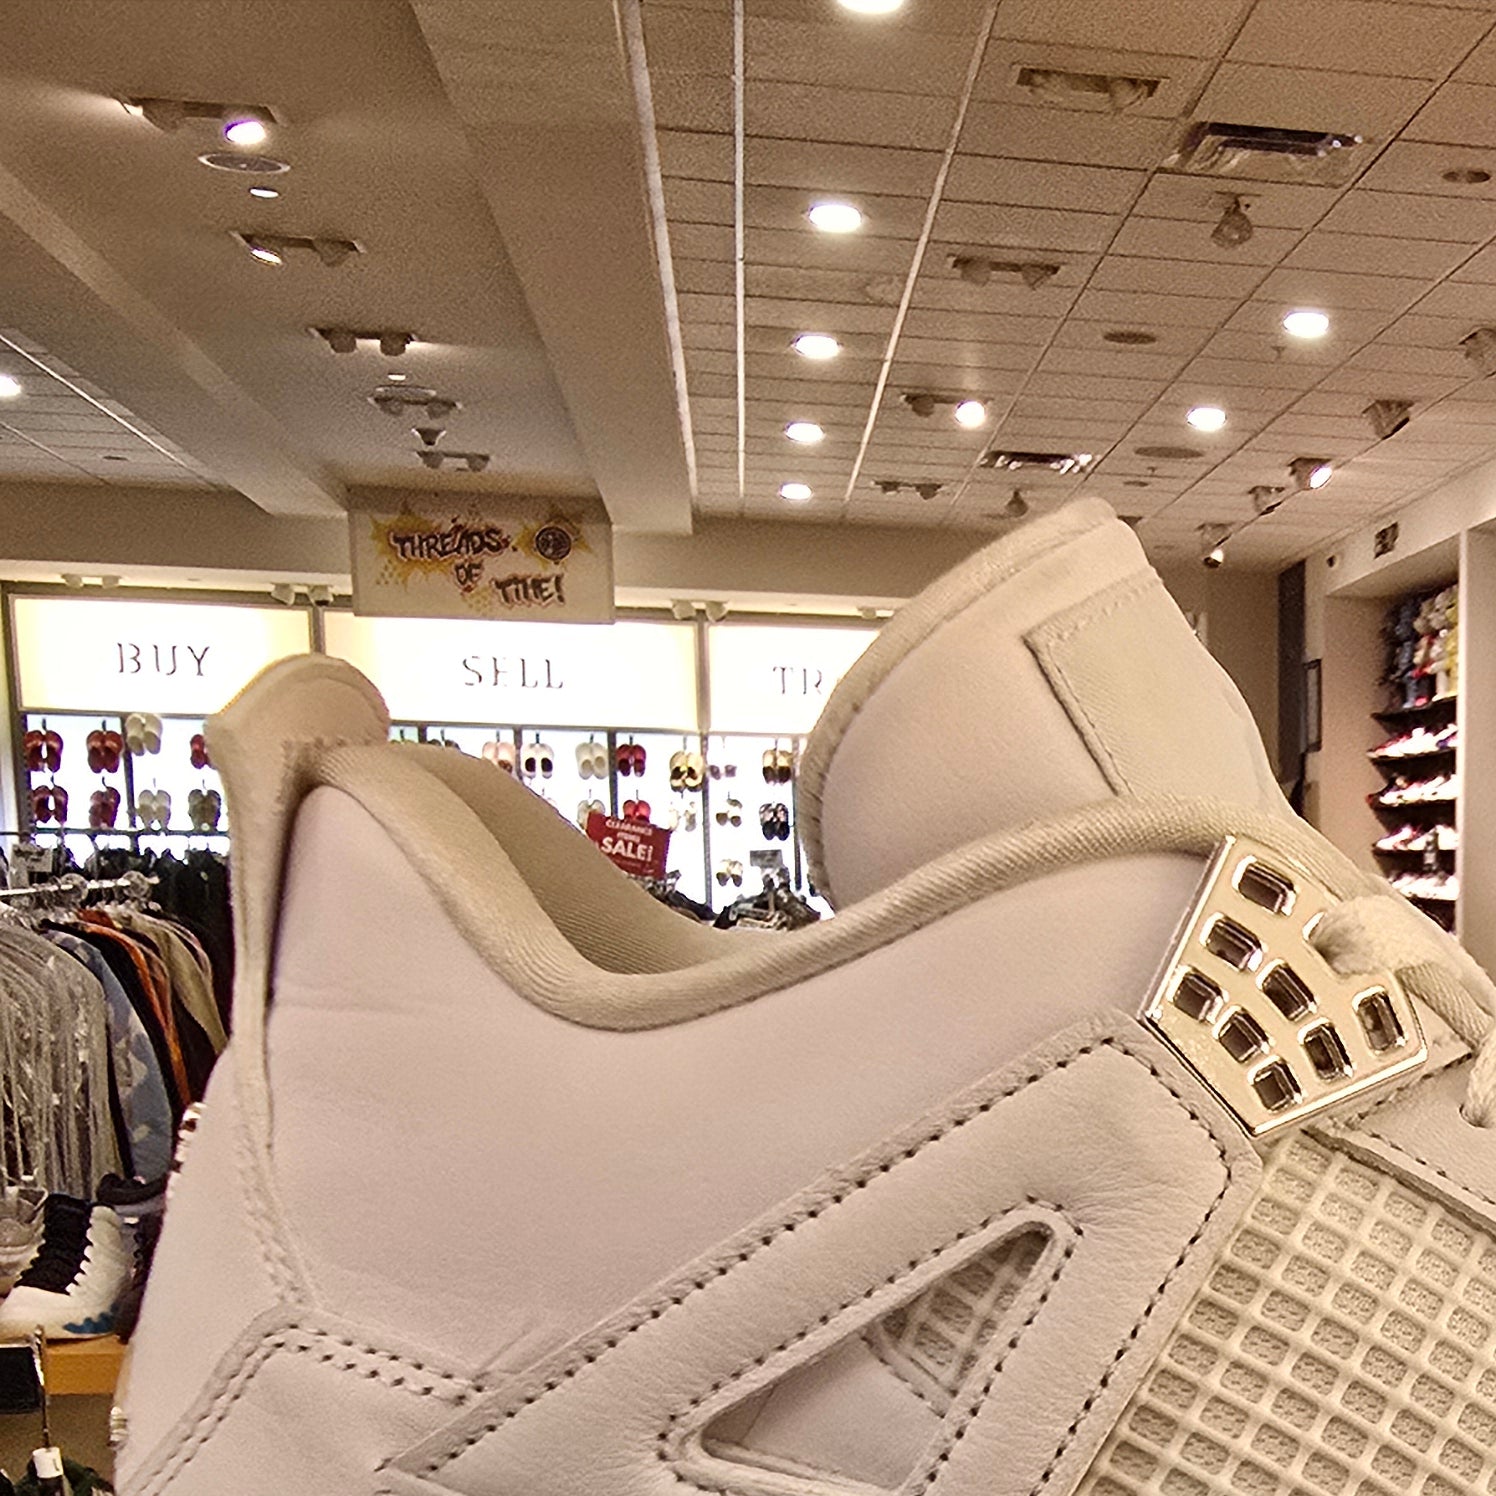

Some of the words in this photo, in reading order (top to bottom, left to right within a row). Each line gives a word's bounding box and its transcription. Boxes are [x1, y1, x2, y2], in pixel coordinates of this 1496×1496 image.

[454, 563, 482, 586] OF
[117, 642, 210, 676] BUY
[462, 655, 563, 689] SELL
[600, 836, 654, 862] SALE!
